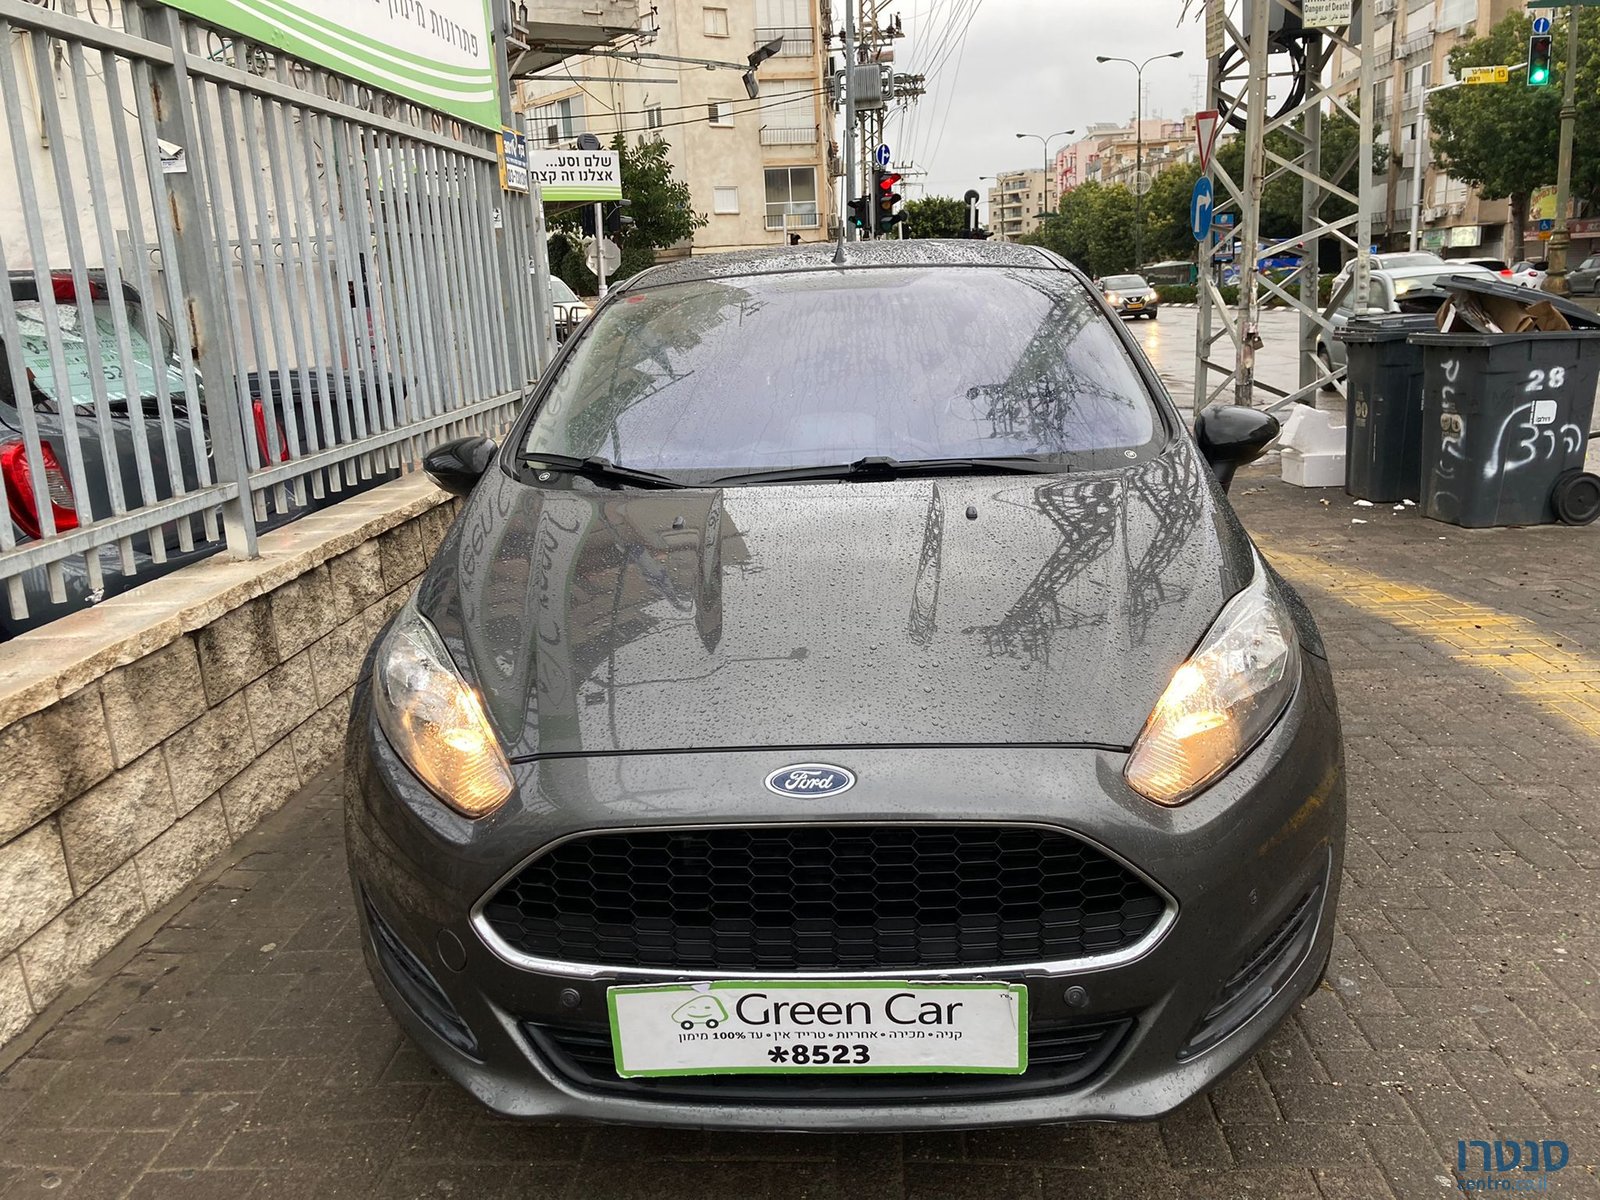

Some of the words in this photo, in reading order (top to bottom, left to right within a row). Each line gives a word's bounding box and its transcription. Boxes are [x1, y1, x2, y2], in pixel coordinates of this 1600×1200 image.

[1304, 4, 1324, 14] Danger
[1324, 3, 1331, 11] of
[429, 9, 479, 58] פתרונות
[1497, 69, 1506, 78] 13
[545, 156, 580, 167] וסע...
[584, 154, 612, 167] שלם
[561, 171, 575, 181] זה
[578, 168, 613, 181] אצלנו
[1525, 366, 1565, 392] 28
[784, 770, 834, 790] Ford
[735, 993, 872, 1026] Green
[884, 992, 964, 1026] Car
[678, 1032, 709, 1043] מימון
[712, 1031, 747, 1041] 100%
[748, 1031, 763, 1040] עד
[773, 1031, 791, 1041] אין
[794, 1031, 826, 1040] טרייד
[836, 1031, 878, 1040] אחריות
[888, 1031, 926, 1040] מכירה
[935, 1031, 963, 1041] קניה
